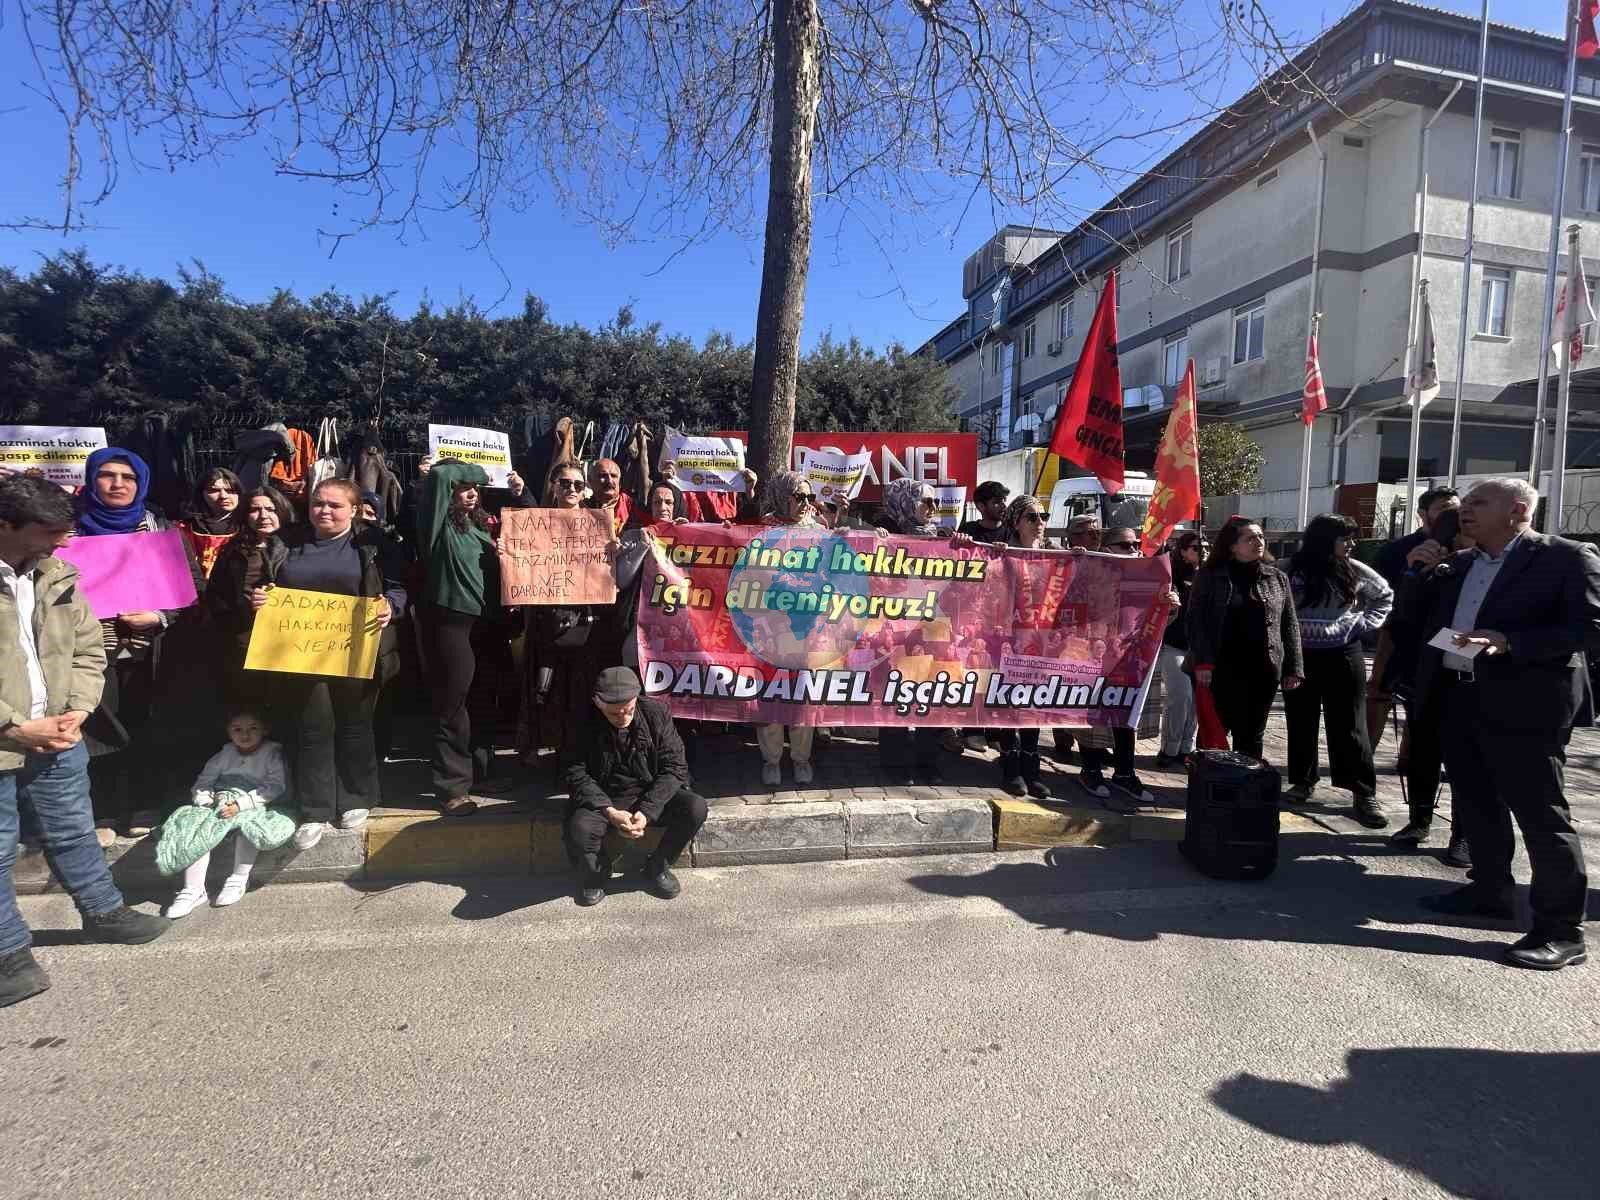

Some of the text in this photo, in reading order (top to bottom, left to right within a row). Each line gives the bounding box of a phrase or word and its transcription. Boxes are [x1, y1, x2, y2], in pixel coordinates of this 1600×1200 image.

[436, 435, 481, 449] Tazminat
[439, 450, 463, 461] gasp
[676, 446, 716, 457] Tazminat
[652, 536, 987, 583] Tazminat hakkımız
[539, 570, 575, 588] VER
[267, 589, 348, 613] SADAKA
[509, 586, 570, 600] DARDANEL
[648, 573, 938, 621] için direniyoruz!
[642, 658, 1142, 717] DARDANEL işçisi kadınlar
